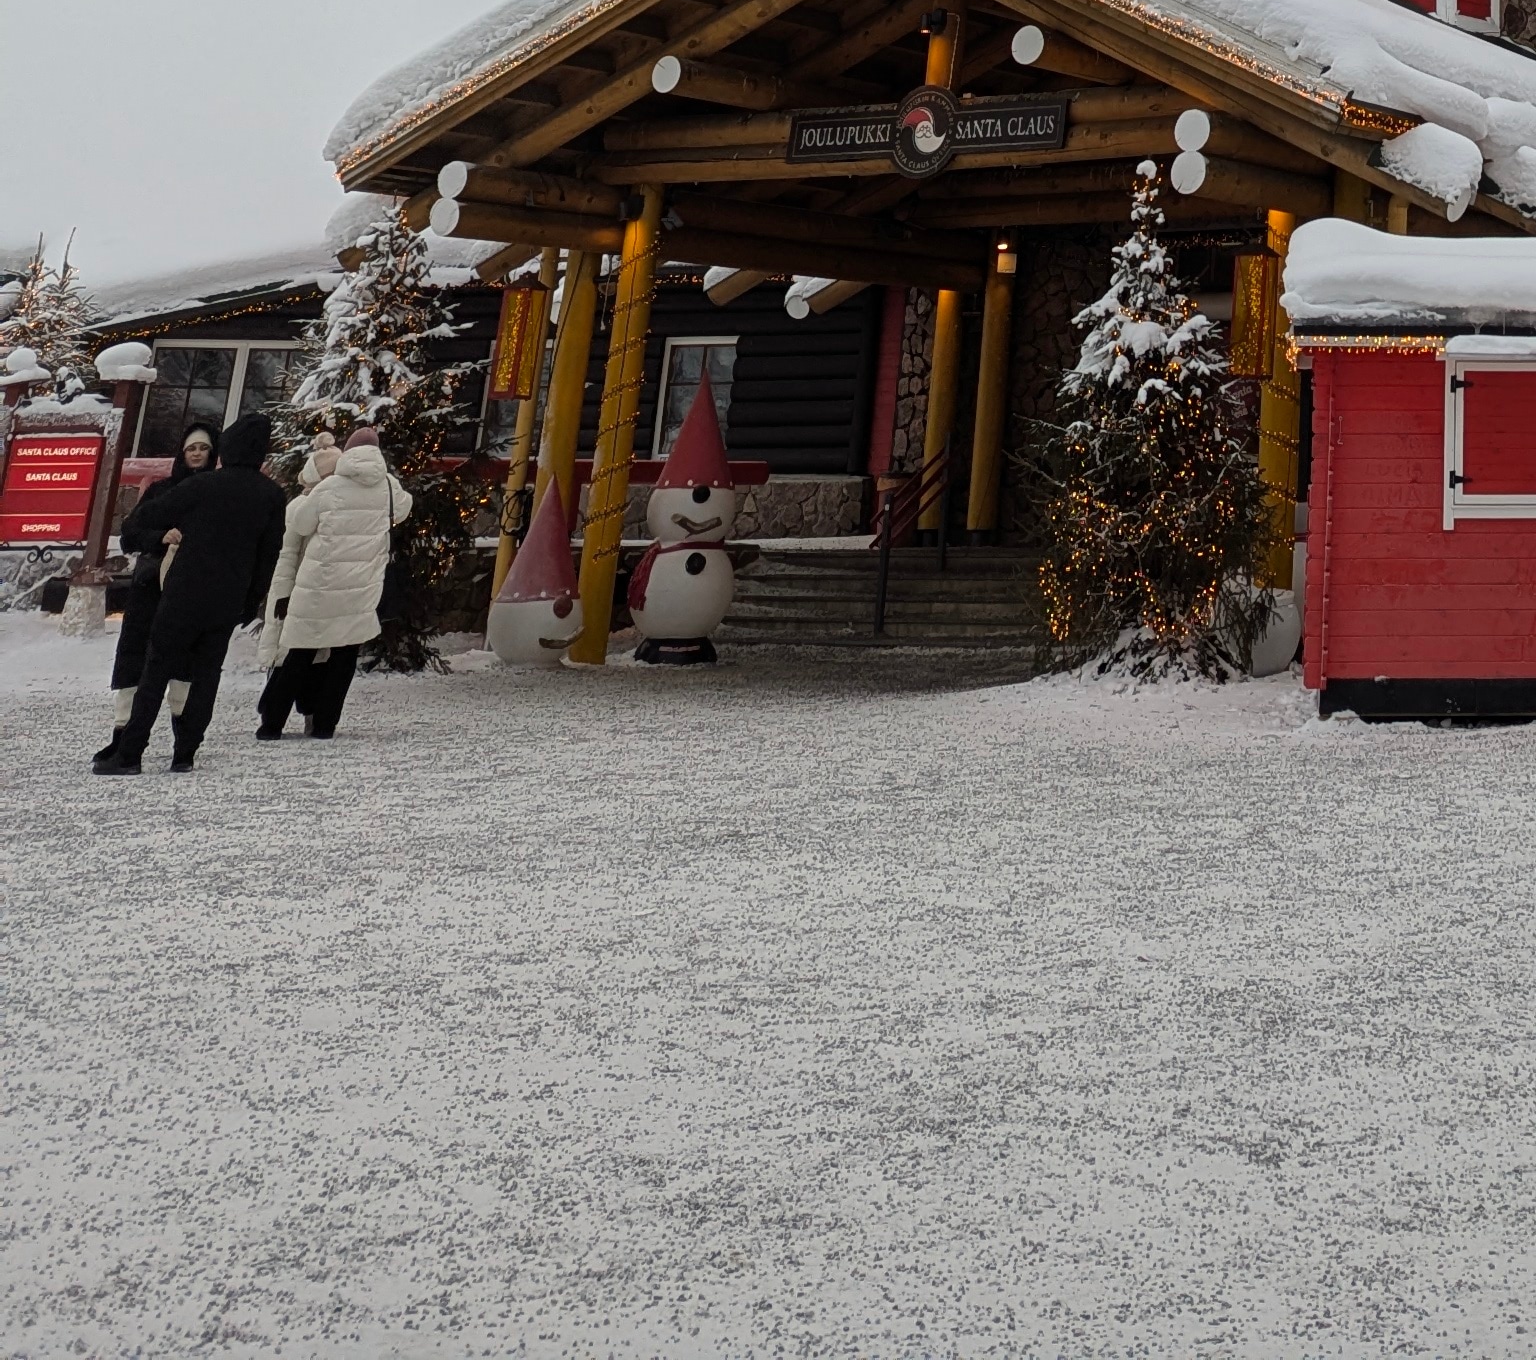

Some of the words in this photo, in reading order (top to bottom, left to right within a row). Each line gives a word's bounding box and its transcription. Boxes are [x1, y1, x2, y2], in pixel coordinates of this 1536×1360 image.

[800, 124, 891, 150] JOULUPUKKI
[955, 118, 1002, 140] SANTA
[1008, 114, 1055, 137] CLAUS
[17, 448, 42, 456] SANTA
[43, 447, 69, 456] CLAUS
[70, 447, 98, 456] OFFICE
[25, 473, 51, 481] SANTA
[52, 473, 78, 481] CLAUS
[21, 524, 60, 532] SHOPPING
